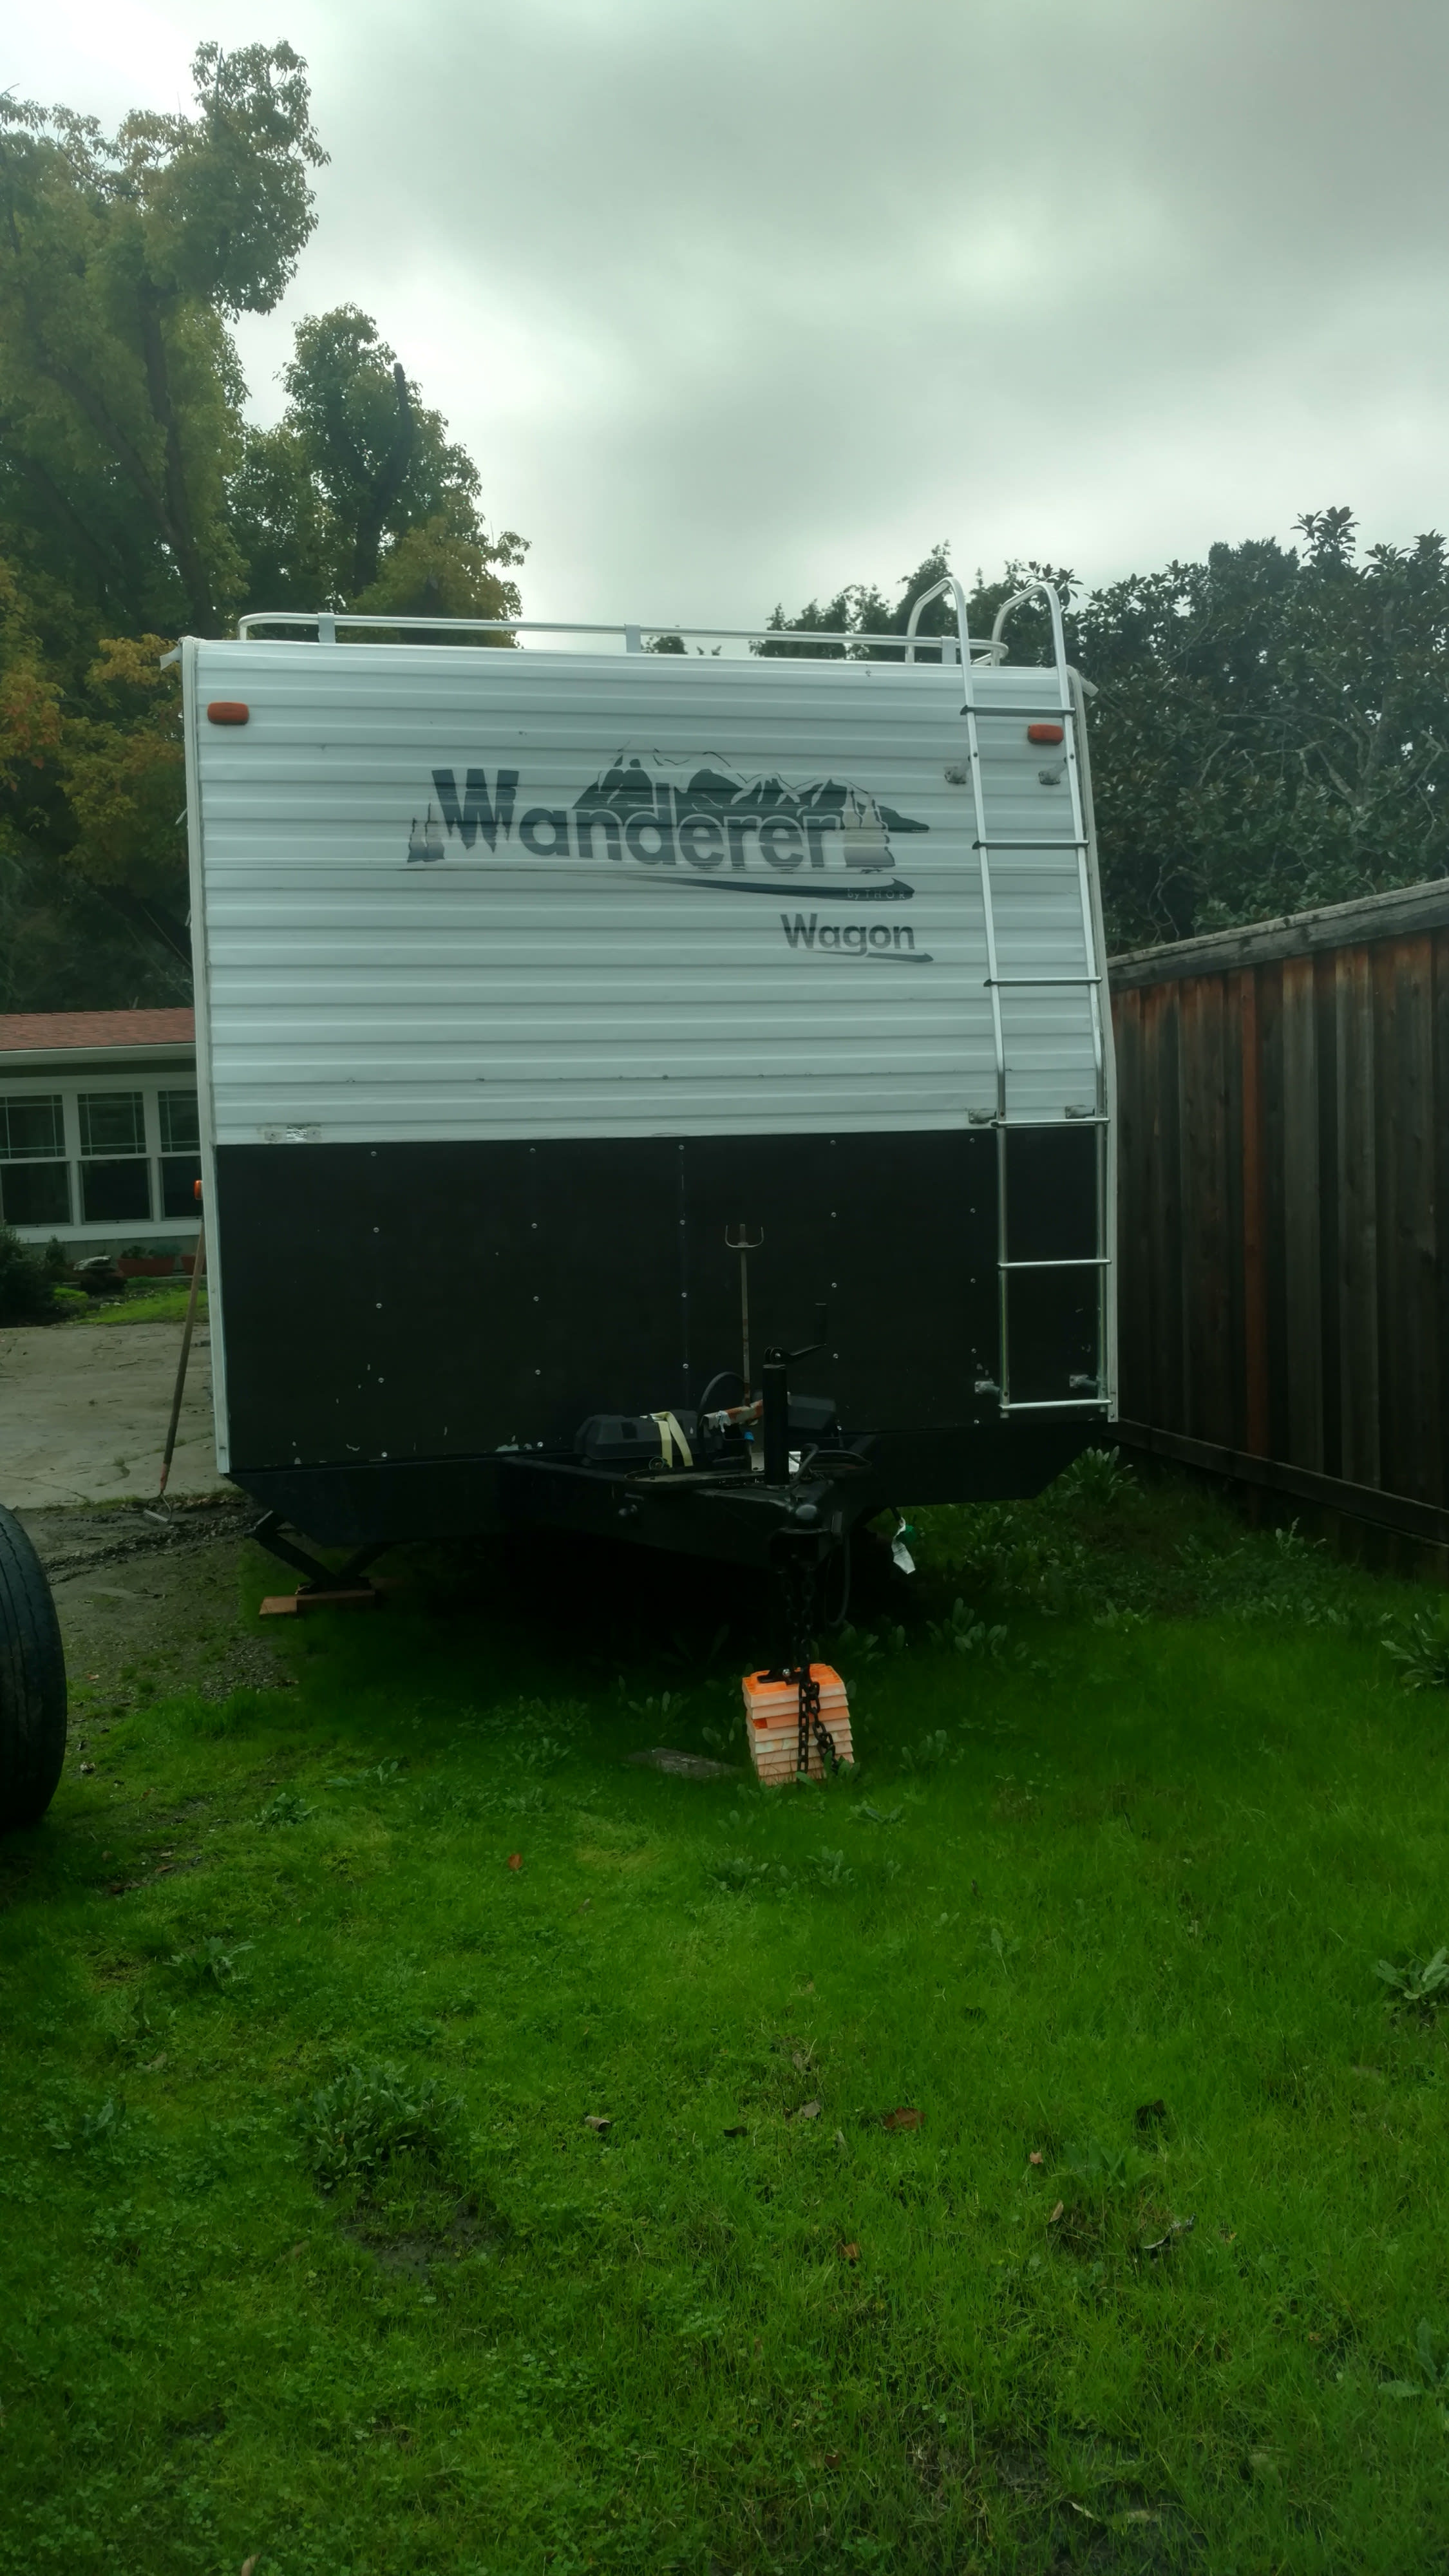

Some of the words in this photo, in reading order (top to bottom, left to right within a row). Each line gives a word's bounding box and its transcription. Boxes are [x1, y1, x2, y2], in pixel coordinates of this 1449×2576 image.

[431, 768, 840, 868] Wanderer
[847, 887, 860, 900] by
[865, 889, 905, 900] THOR
[779, 913, 916, 957] Wagon
